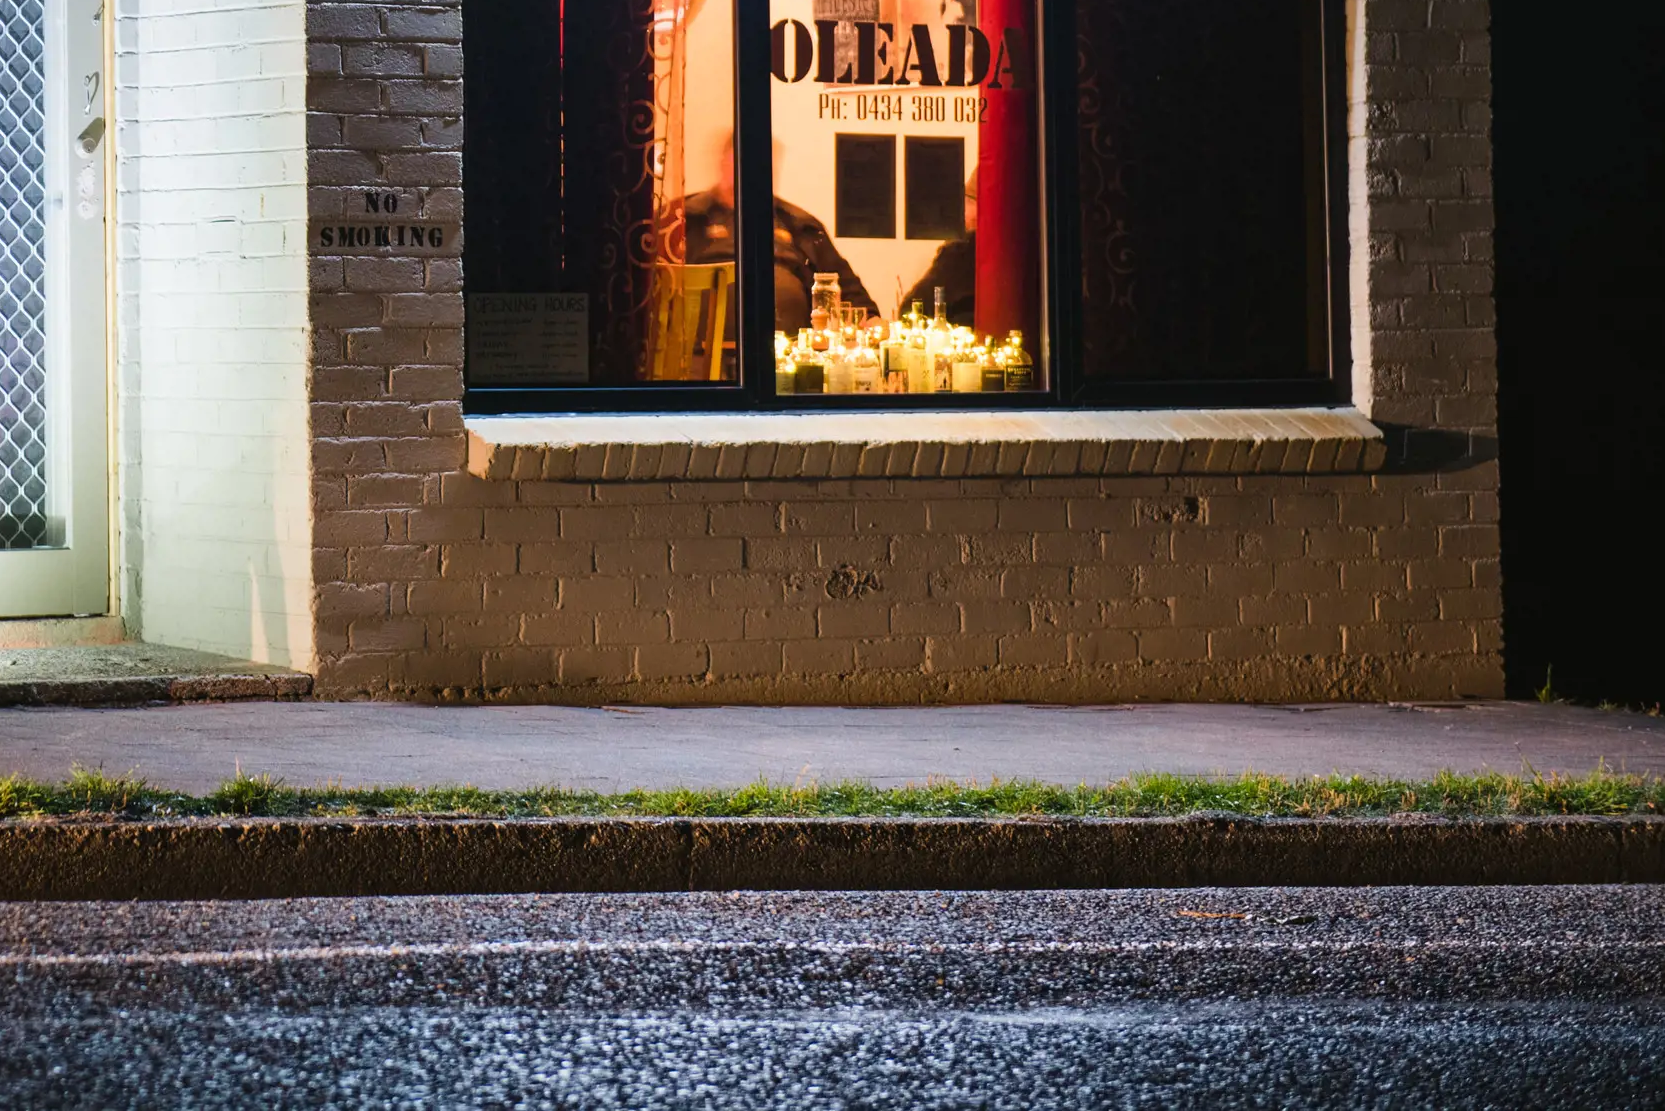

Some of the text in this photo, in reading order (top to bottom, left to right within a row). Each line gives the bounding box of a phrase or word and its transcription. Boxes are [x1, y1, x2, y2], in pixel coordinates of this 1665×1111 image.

[770, 18, 1036, 90] OLEADA
[857, 94, 903, 122] 0434
[912, 96, 945, 123] 380
[954, 97, 988, 124] 032
[365, 192, 398, 214] NO
[320, 225, 443, 248] SMOKING
